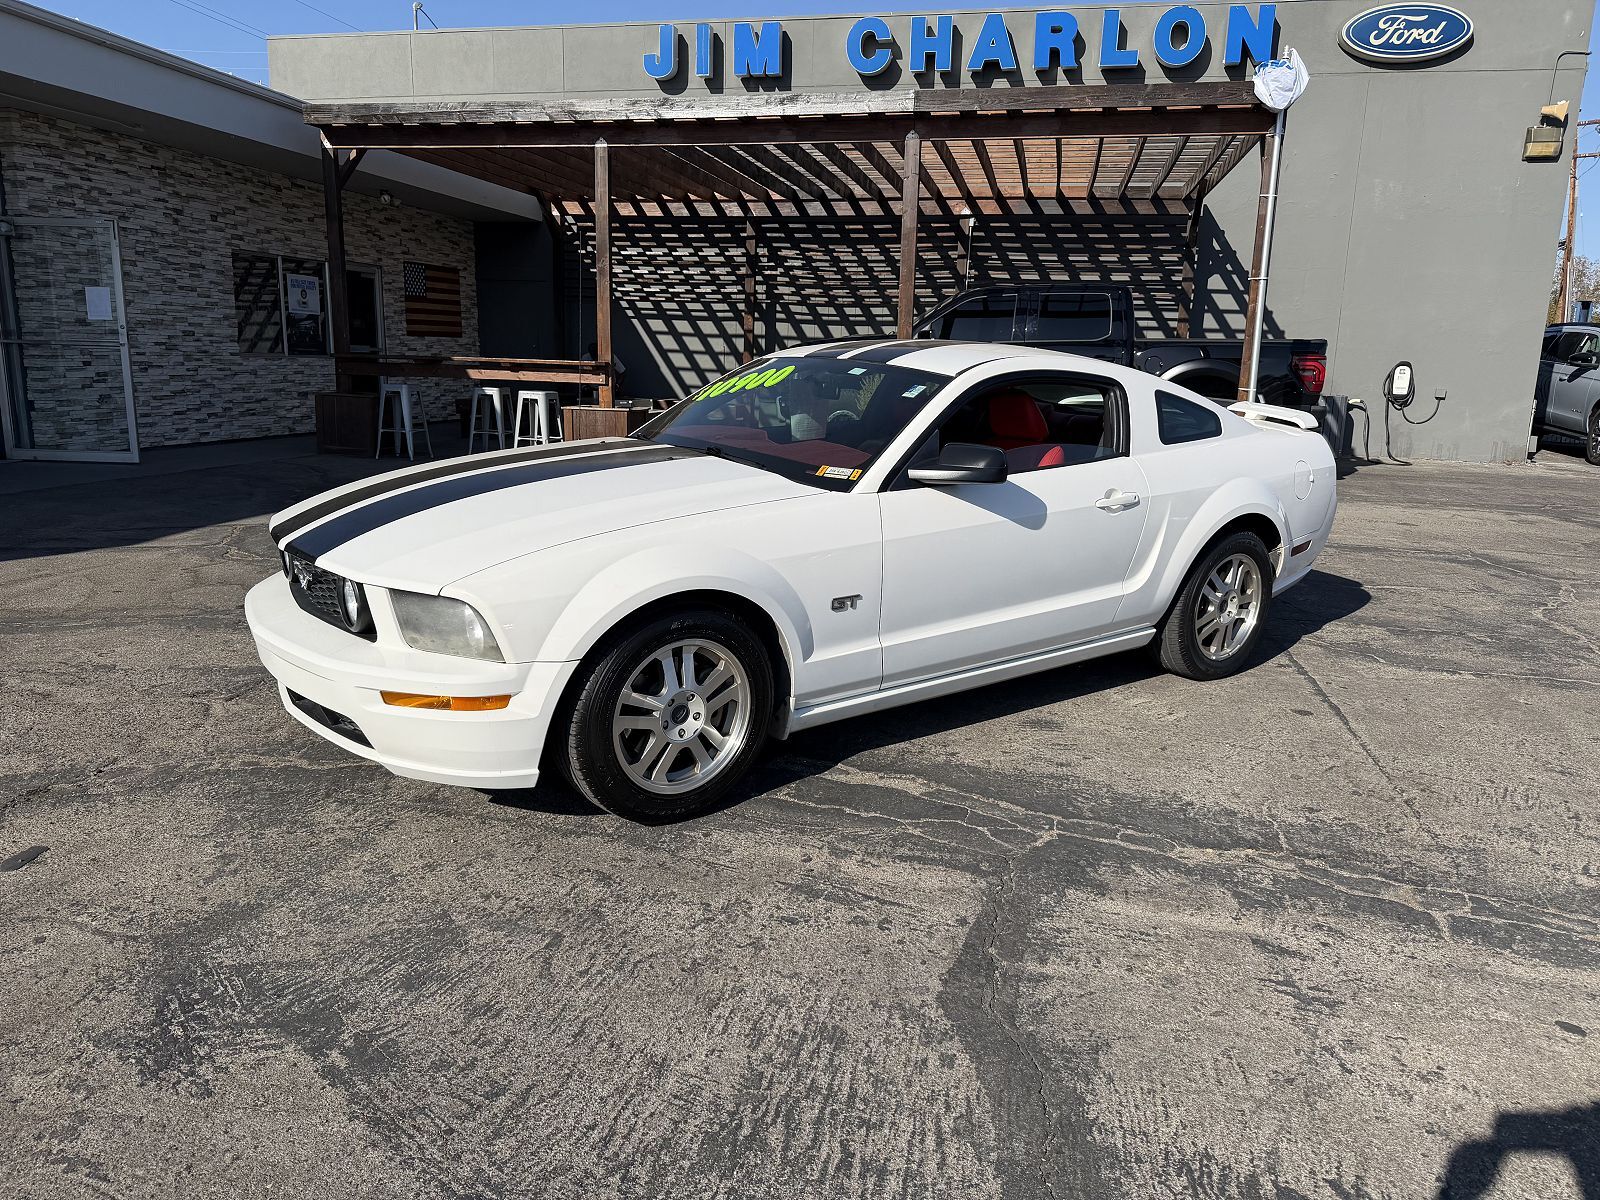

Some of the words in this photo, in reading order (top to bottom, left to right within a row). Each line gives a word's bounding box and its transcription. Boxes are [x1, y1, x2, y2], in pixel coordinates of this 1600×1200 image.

[642, 22, 784, 81] JIM
[846, 4, 1277, 76] CHARLON
[1369, 14, 1448, 46] Ford
[831, 593, 864, 613] GT
